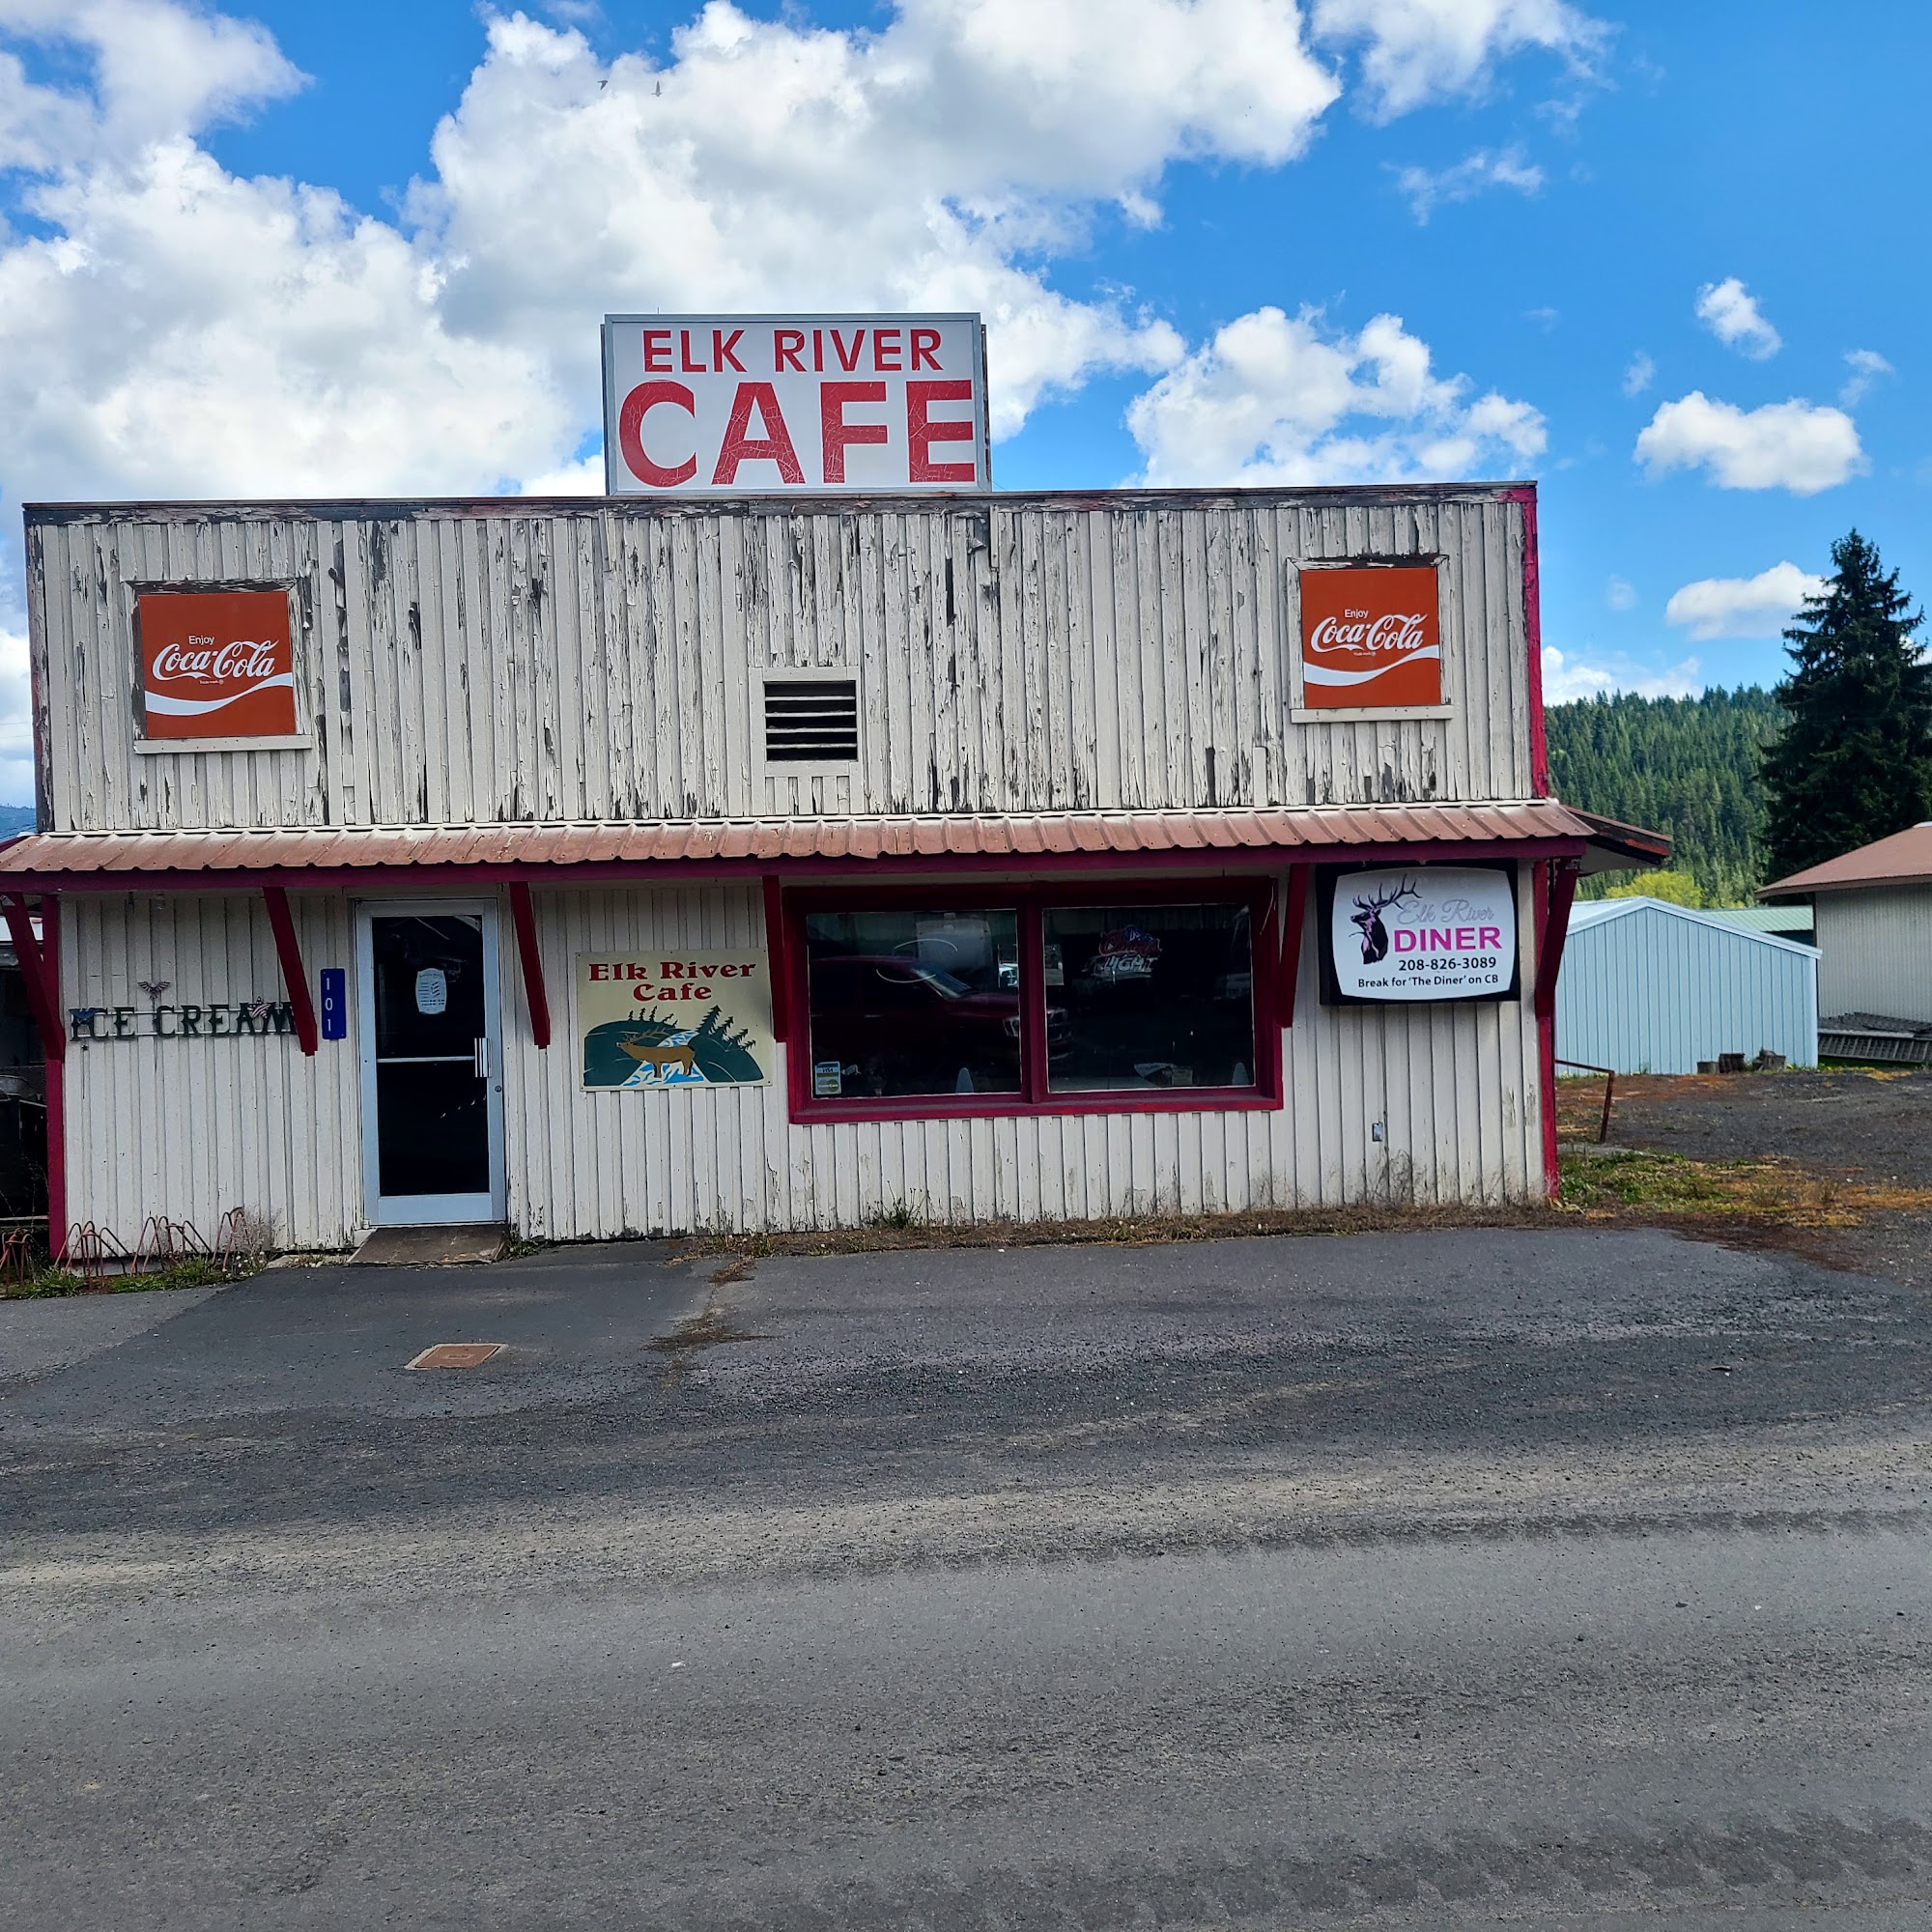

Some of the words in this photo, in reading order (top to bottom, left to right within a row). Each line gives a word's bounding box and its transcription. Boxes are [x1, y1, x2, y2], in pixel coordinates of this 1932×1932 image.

[642, 328, 748, 373] ELK
[773, 327, 944, 373] RIVER
[618, 378, 977, 488] CAFE
[1344, 609, 1369, 619] Enjoy
[188, 635, 214, 646] Enjoy
[1310, 613, 1428, 653] Coca-Cola
[152, 639, 280, 681] Coca-Cola
[1396, 899, 1436, 924] Elk
[1441, 898, 1494, 923] River
[1393, 926, 1503, 952] DINER
[588, 962, 648, 981] Elk
[660, 961, 756, 980] River
[1398, 956, 1497, 972] 208-826-3089
[633, 982, 712, 1002] Cafe
[1357, 977, 1389, 988] Break
[1391, 977, 1406, 987] for
[1468, 976, 1482, 984] on
[1484, 974, 1498, 984] CB
[325, 977, 333, 1032] 101
[68, 1006, 136, 1041] ICE
[154, 1001, 298, 1038] CREAM
